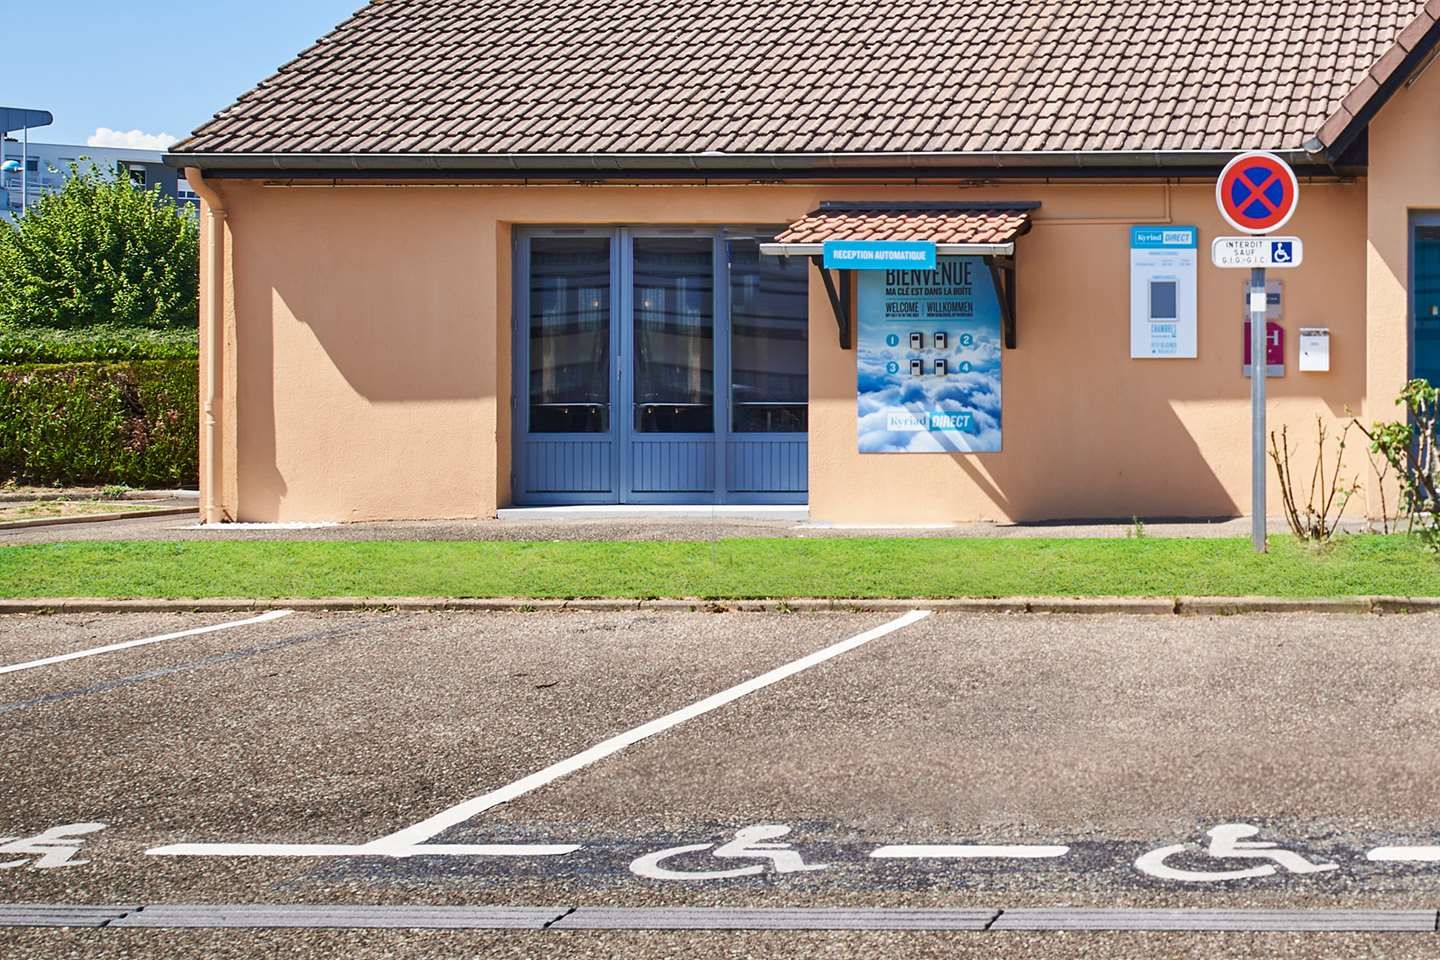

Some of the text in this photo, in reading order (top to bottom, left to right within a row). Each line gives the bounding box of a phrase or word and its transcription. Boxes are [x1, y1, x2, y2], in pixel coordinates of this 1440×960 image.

[1137, 232, 1190, 242] Kyriad DIRECT
[1225, 241, 1263, 249] INTERDIT
[833, 249, 926, 261] RECEPTION AUTOMATIQUE
[885, 262, 972, 286] BIENVENUE
[911, 287, 923, 296] EST
[924, 287, 943, 296] DANS
[943, 287, 952, 296] LA
[885, 302, 919, 313] WELCOME
[926, 302, 973, 313] WILLKOMMEN
[963, 335, 970, 345] 2
[890, 363, 896, 373] 3
[962, 362, 969, 372] 4
[931, 415, 971, 428] DIRECT
